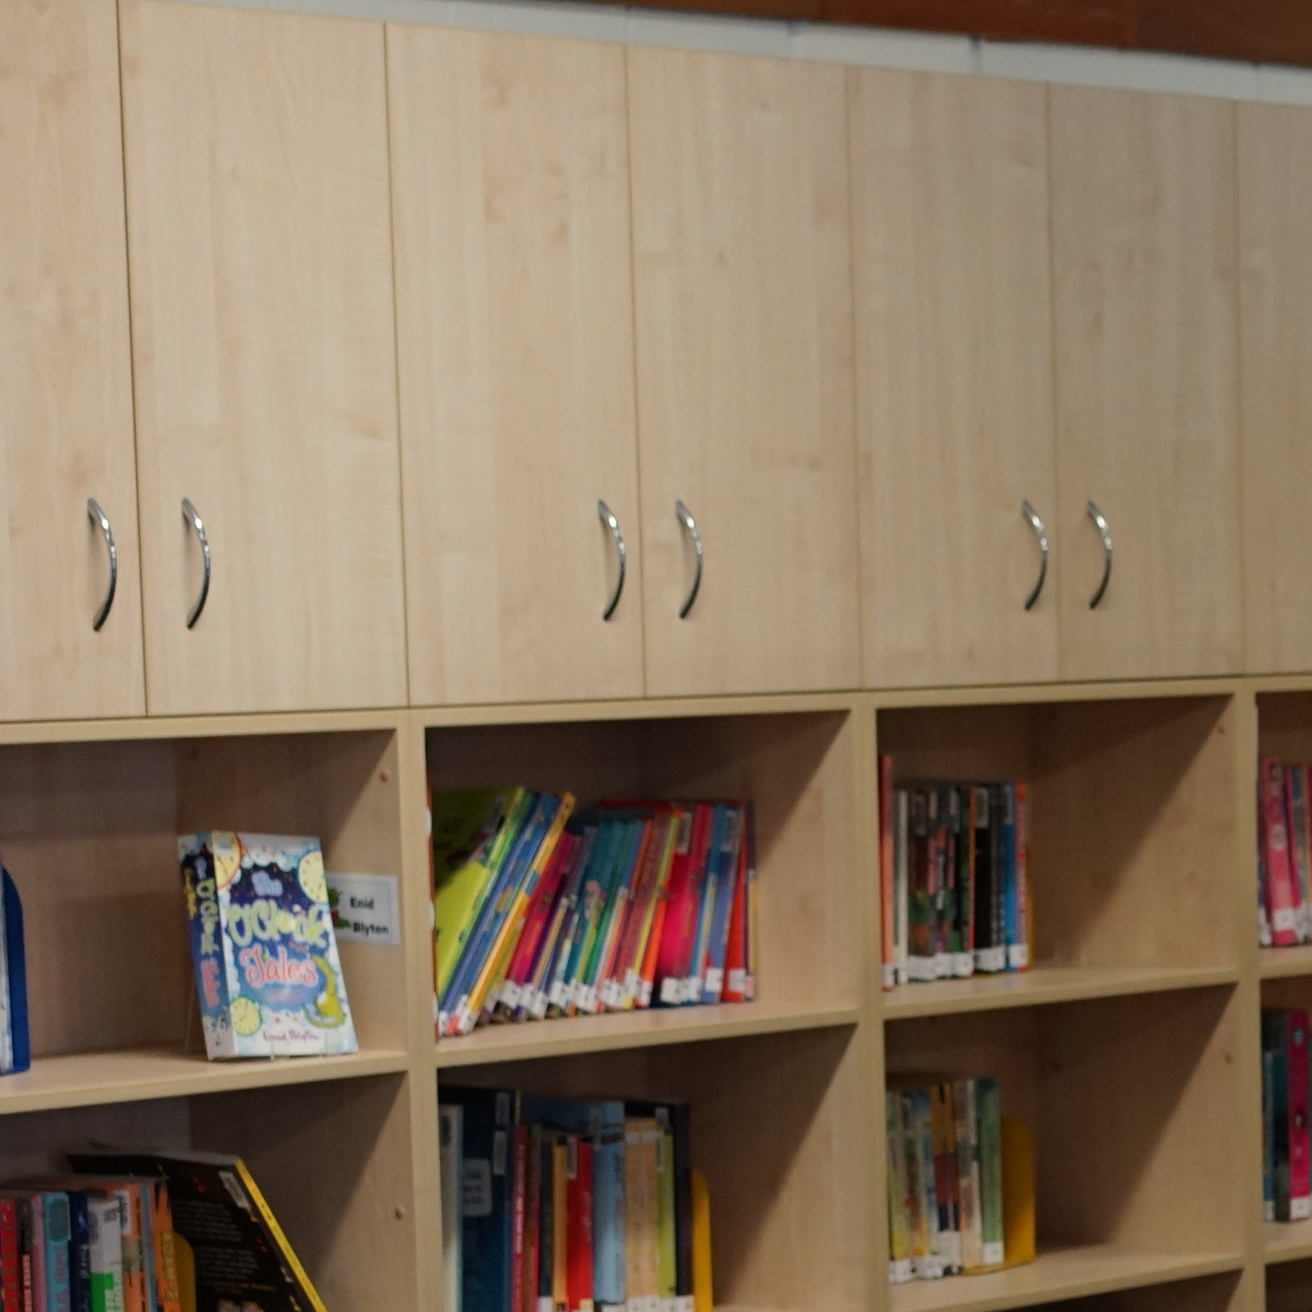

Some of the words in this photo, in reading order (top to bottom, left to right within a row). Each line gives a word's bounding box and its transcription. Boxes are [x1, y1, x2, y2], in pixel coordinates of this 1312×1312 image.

[350, 896, 374, 909] Enid
[353, 922, 389, 936] Blyton
[239, 943, 318, 987] Tales
